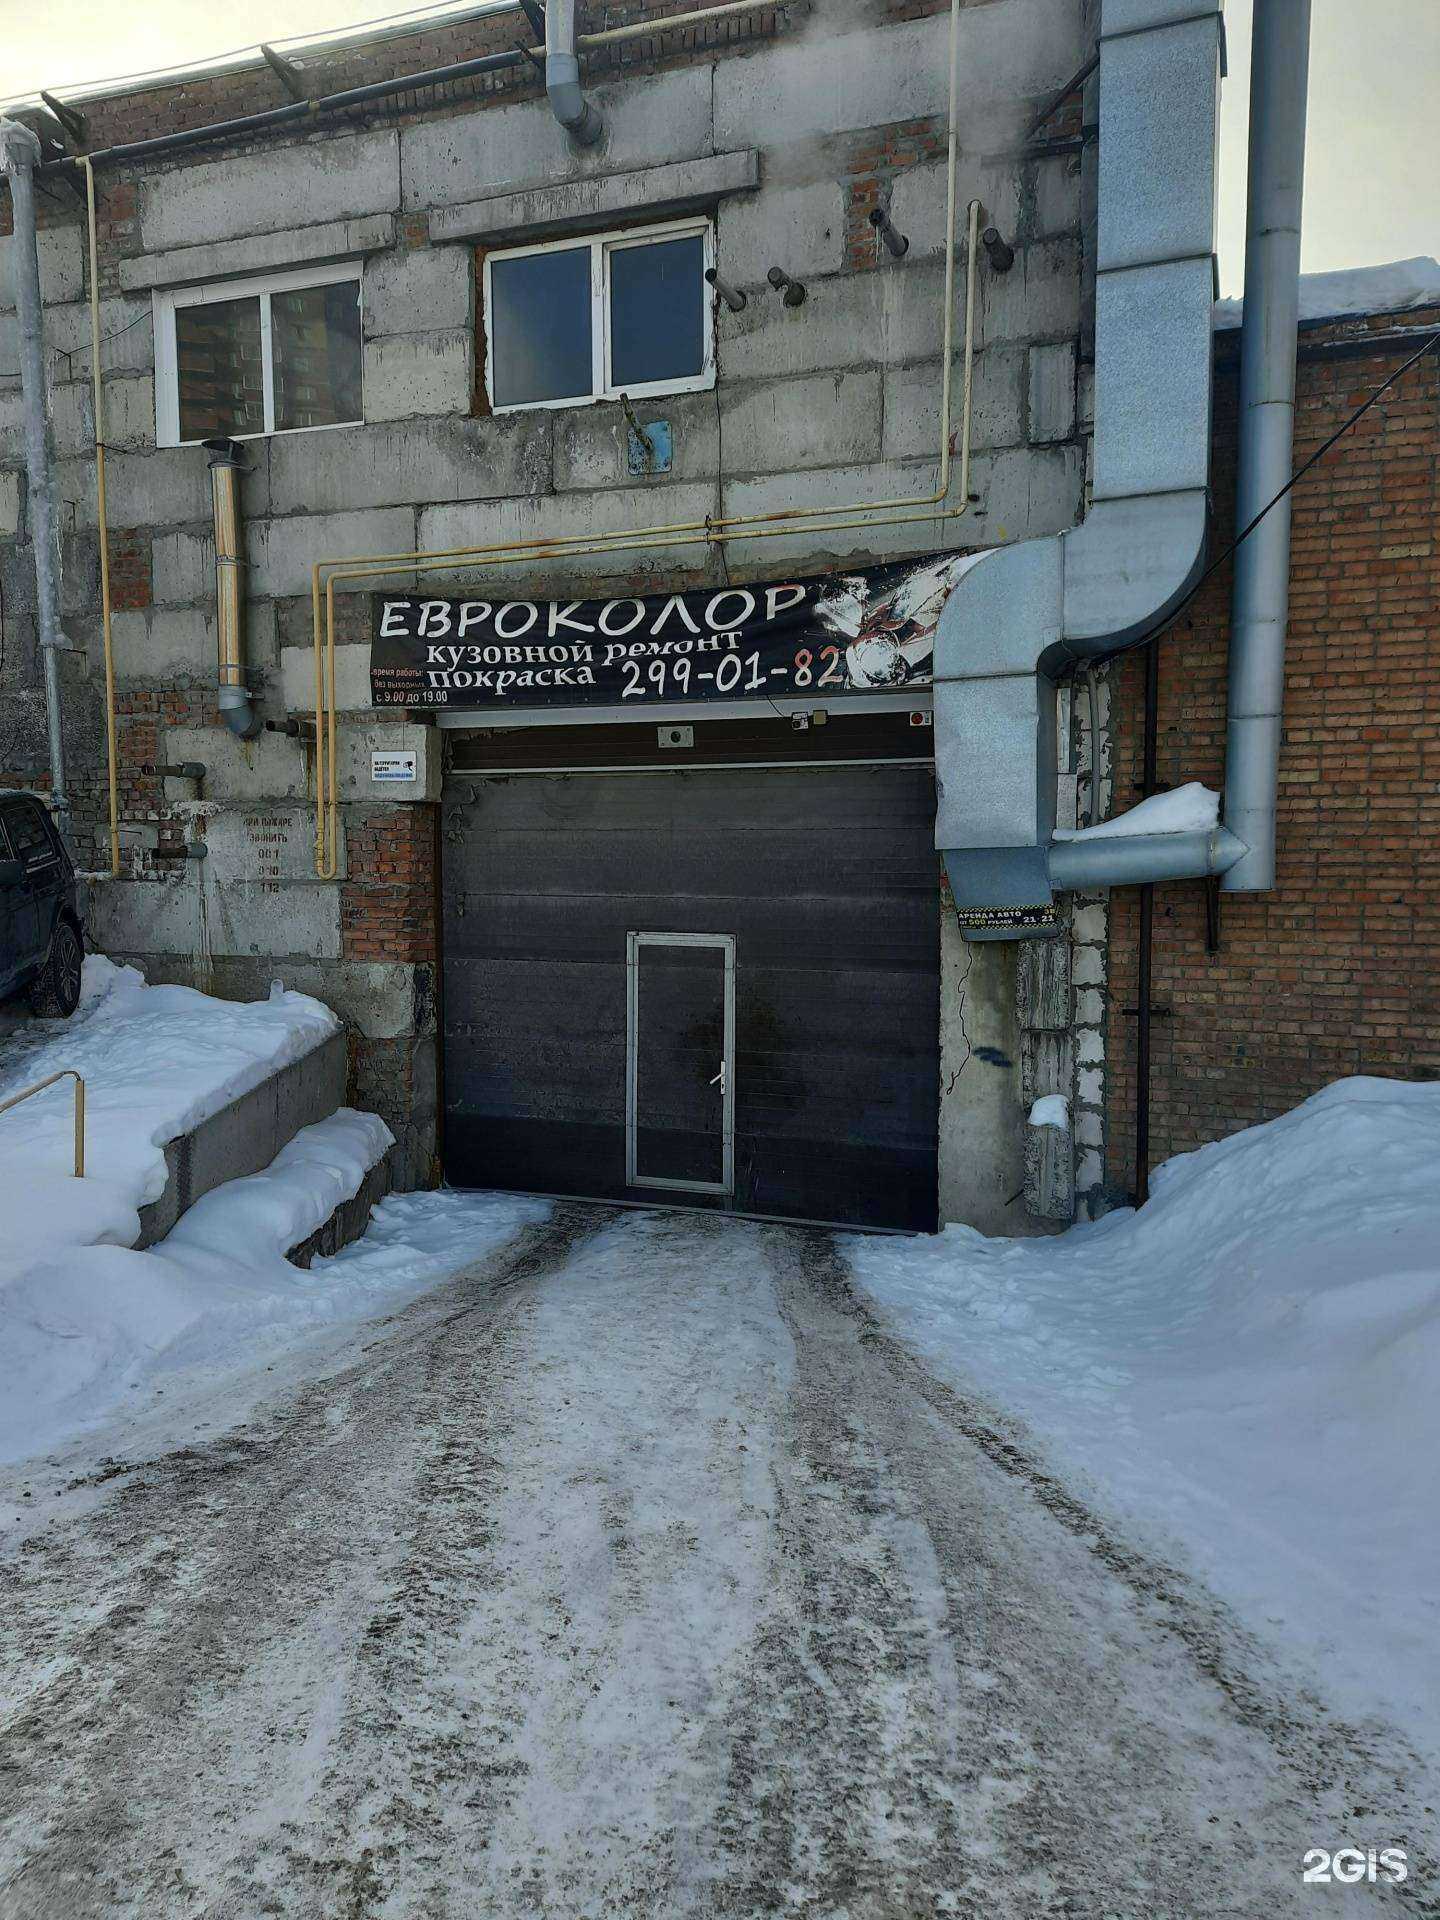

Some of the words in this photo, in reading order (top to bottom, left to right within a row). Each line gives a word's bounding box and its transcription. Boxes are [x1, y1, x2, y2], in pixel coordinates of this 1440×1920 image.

[379, 583, 806, 639] ЕВРОКОЛОР
[426, 639, 594, 671] кузовной
[602, 630, 743, 667] ремонт
[426, 664, 597, 695] покраска
[621, 645, 844, 699] 299-01-82
[384, 690, 405, 703] 9.00
[406, 693, 420, 704] до
[422, 690, 448, 703] 19.00
[260, 882, 280, 893] 112
